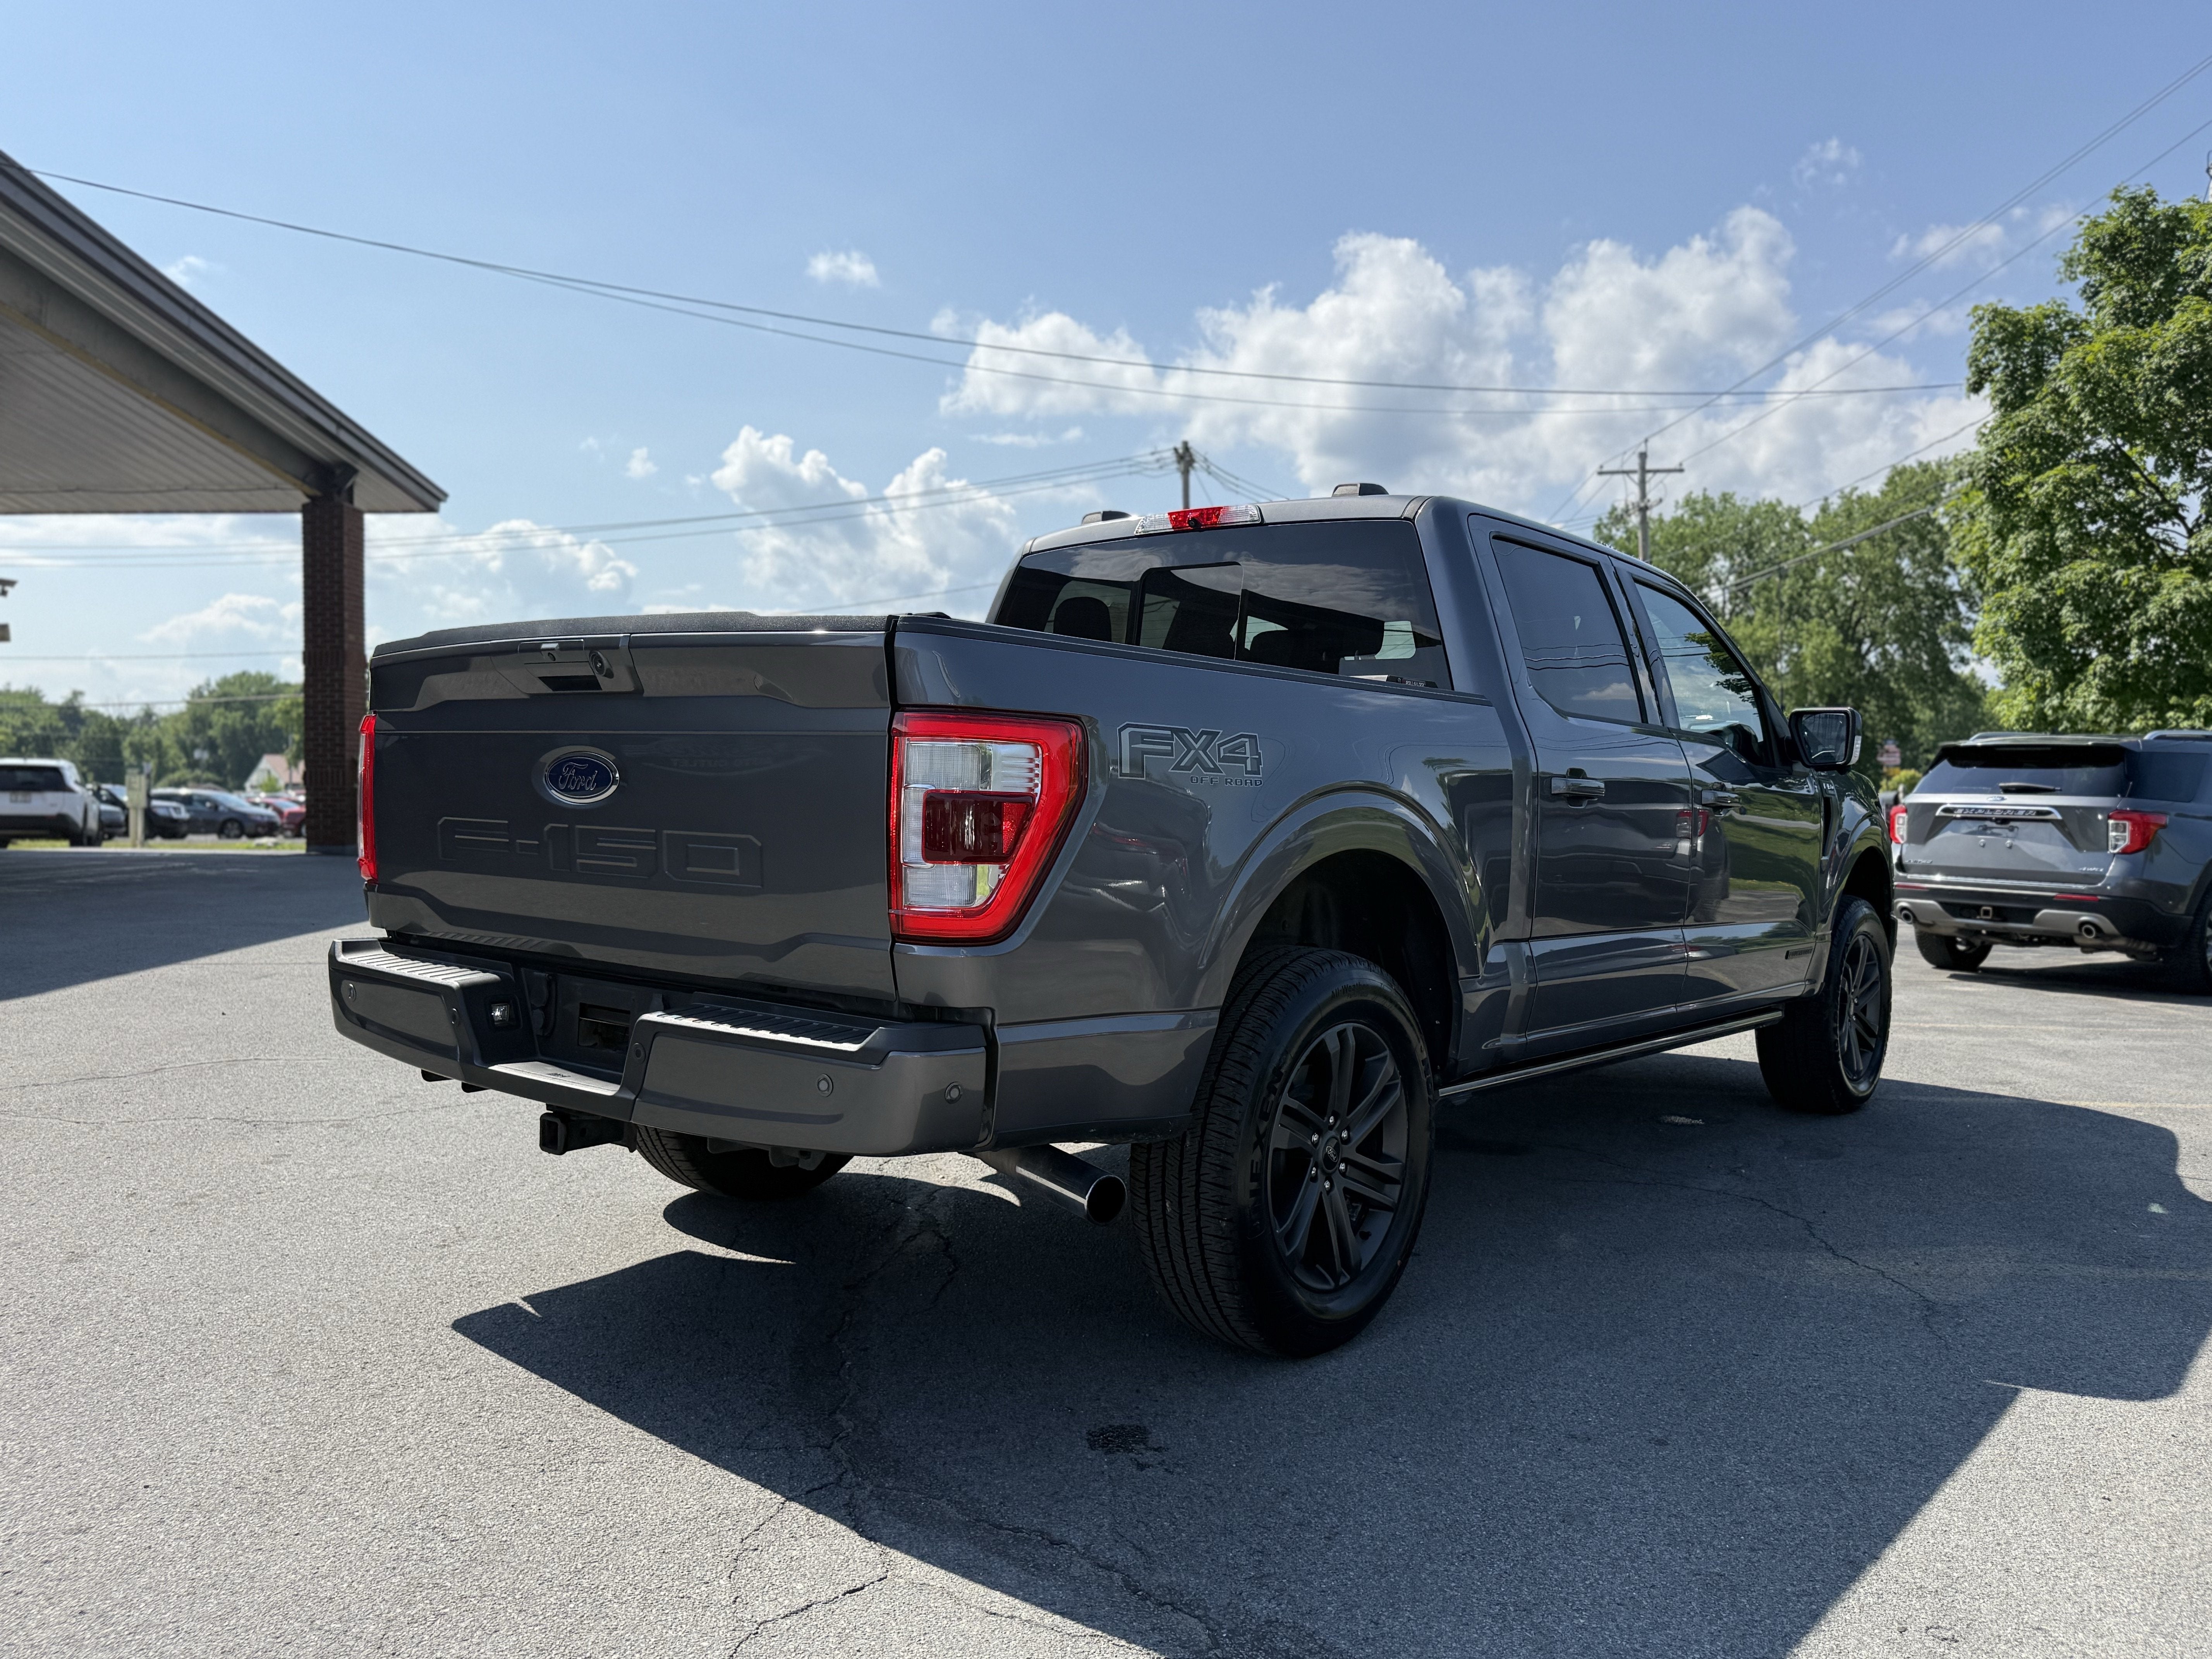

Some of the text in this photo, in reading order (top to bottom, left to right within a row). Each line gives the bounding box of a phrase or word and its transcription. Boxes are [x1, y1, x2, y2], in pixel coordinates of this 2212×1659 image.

[1117, 721, 1263, 779] FX4
[558, 762, 598, 791] Ford
[1190, 775, 1263, 787] OFF ROAD
[436, 816, 764, 888] F-150
